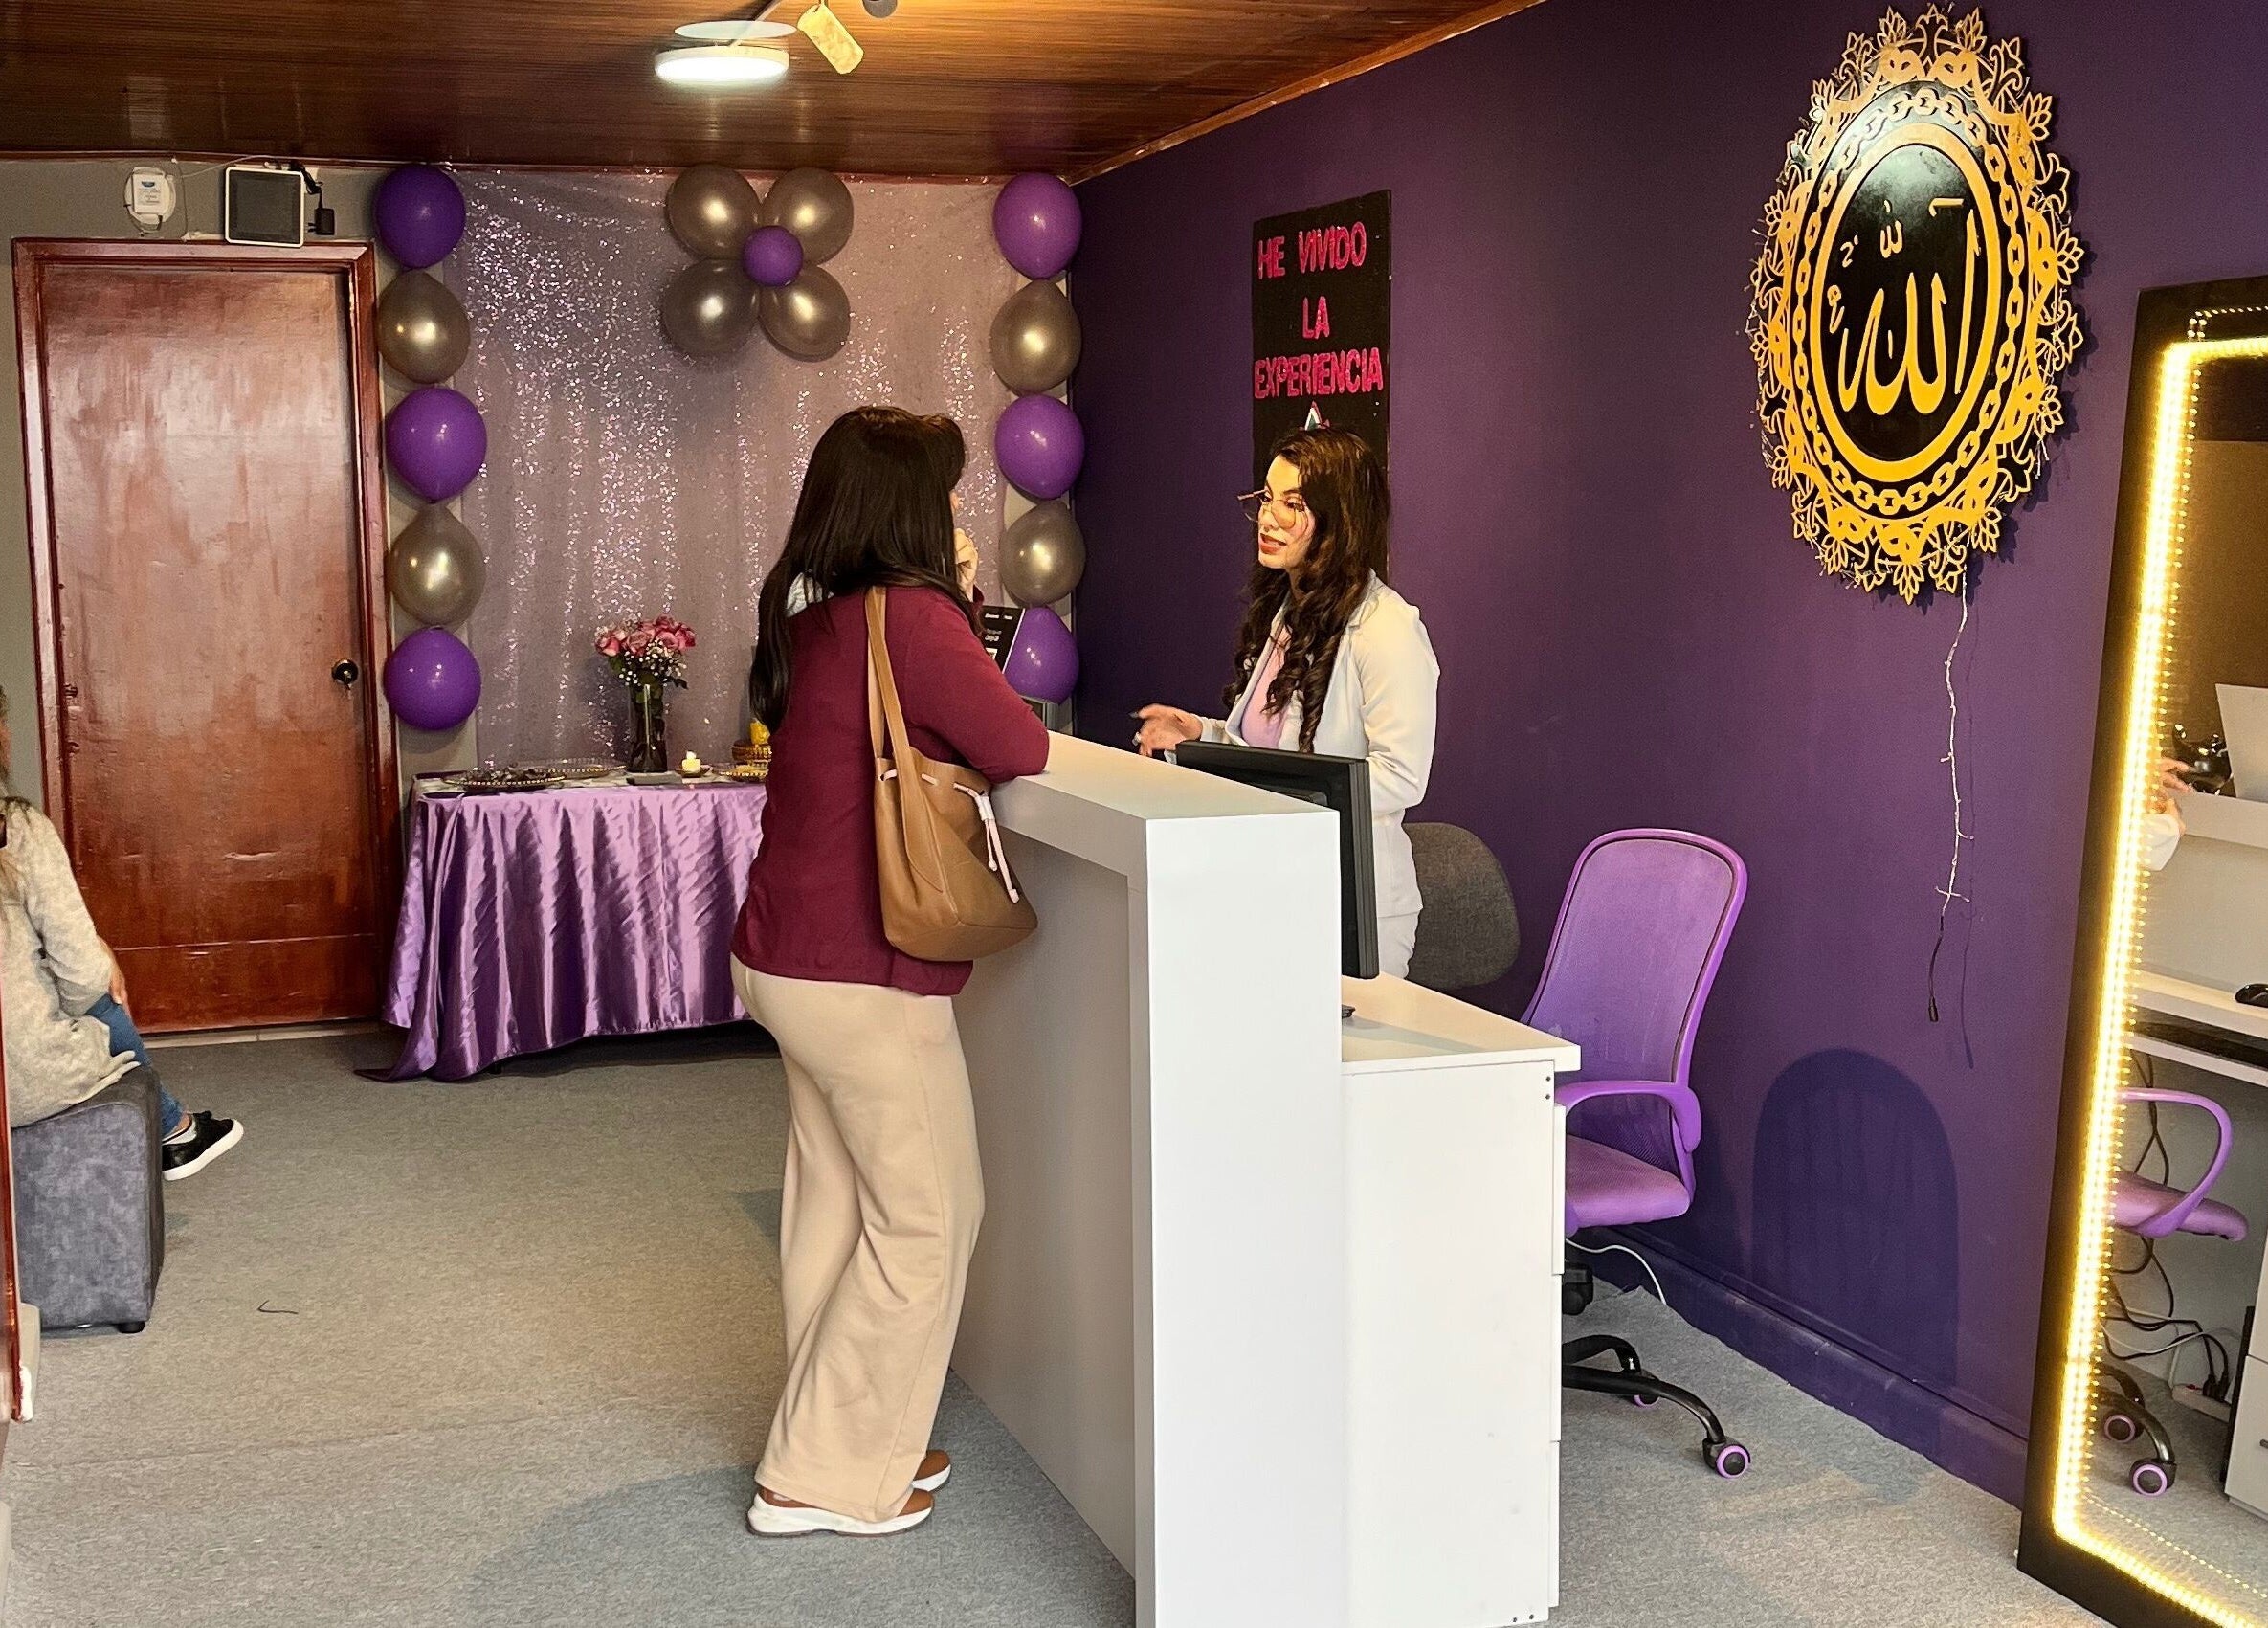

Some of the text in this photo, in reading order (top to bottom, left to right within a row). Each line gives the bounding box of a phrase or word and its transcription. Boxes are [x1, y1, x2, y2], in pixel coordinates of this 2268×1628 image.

[1257, 221, 1367, 279] HE VIVIDO
[1302, 296, 1330, 339] LA
[1254, 347, 1384, 399] EXPERIENCIA
